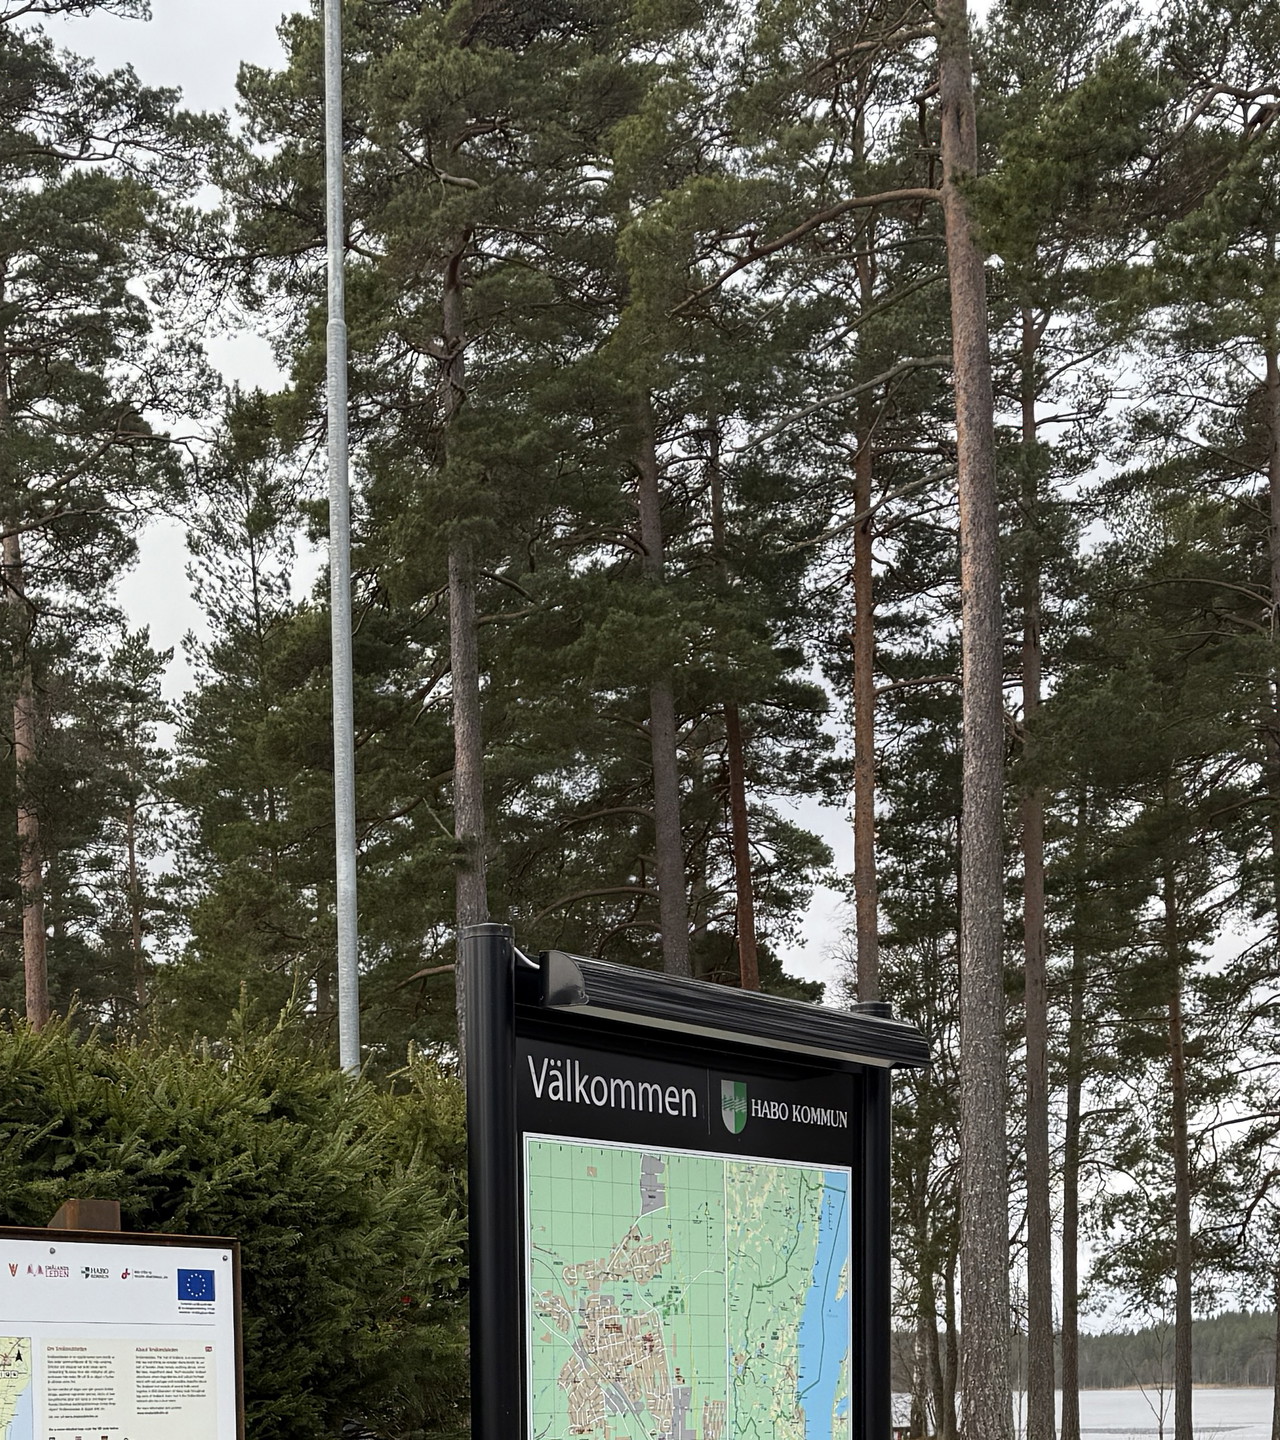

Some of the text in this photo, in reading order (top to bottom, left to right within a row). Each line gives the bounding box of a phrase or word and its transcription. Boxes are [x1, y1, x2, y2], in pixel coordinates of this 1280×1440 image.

[527, 1055, 697, 1118] Välkommen
[751, 1098, 848, 1128] HABO KOMMUN
